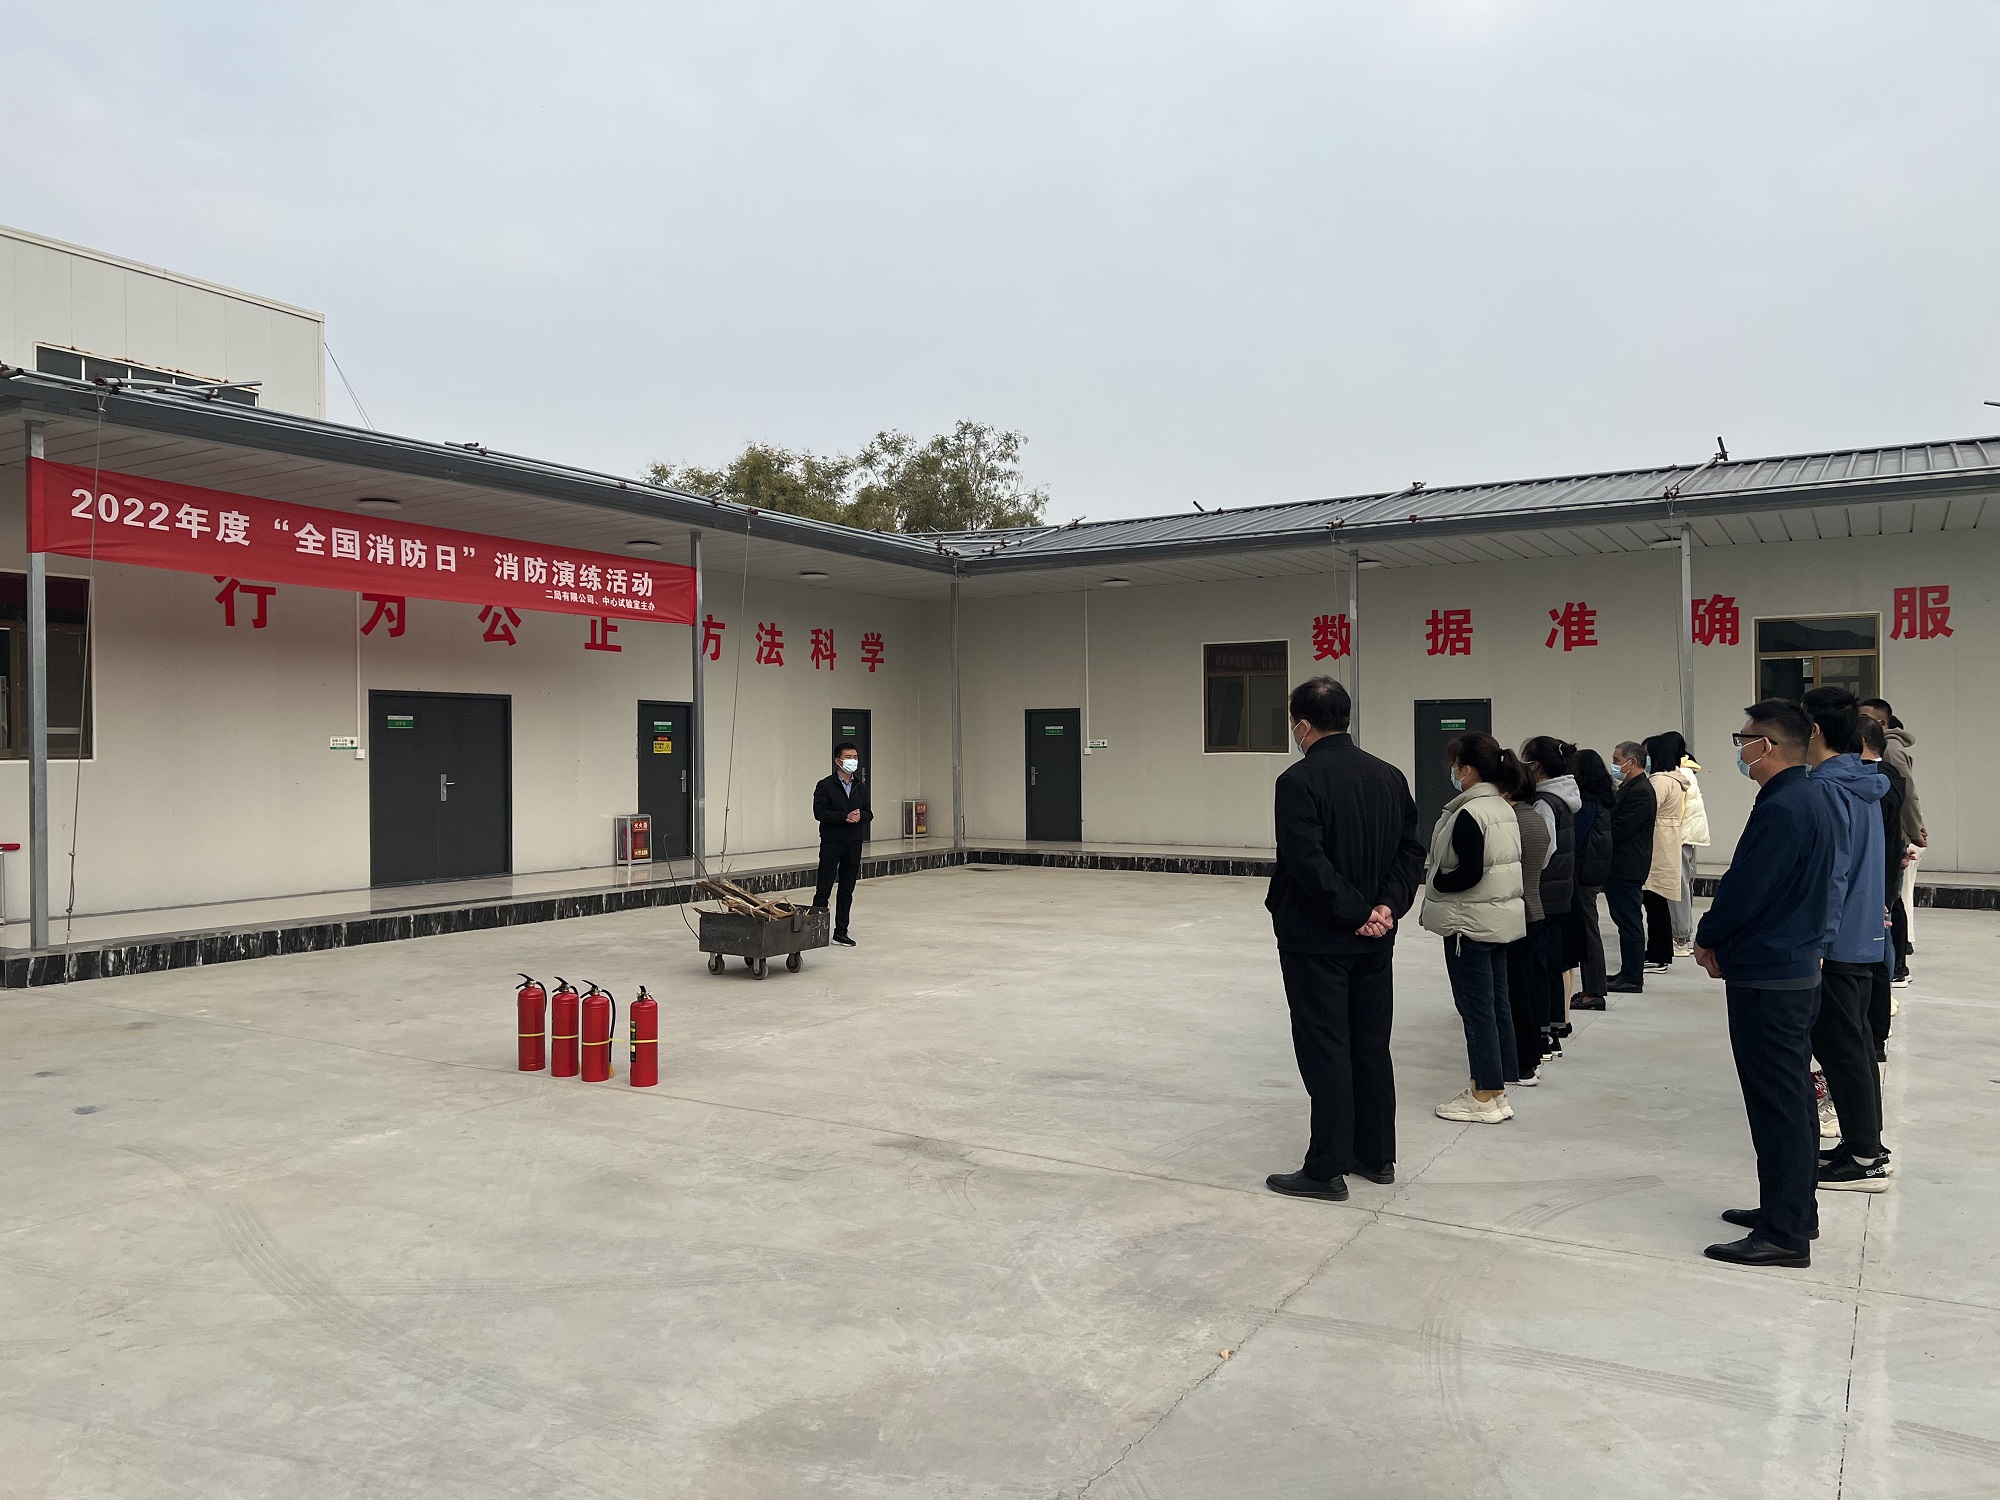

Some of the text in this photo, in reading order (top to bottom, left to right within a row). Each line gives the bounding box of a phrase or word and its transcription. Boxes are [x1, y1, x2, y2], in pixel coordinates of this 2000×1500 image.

[1312, 585, 1954, 661] 数据准确 服
